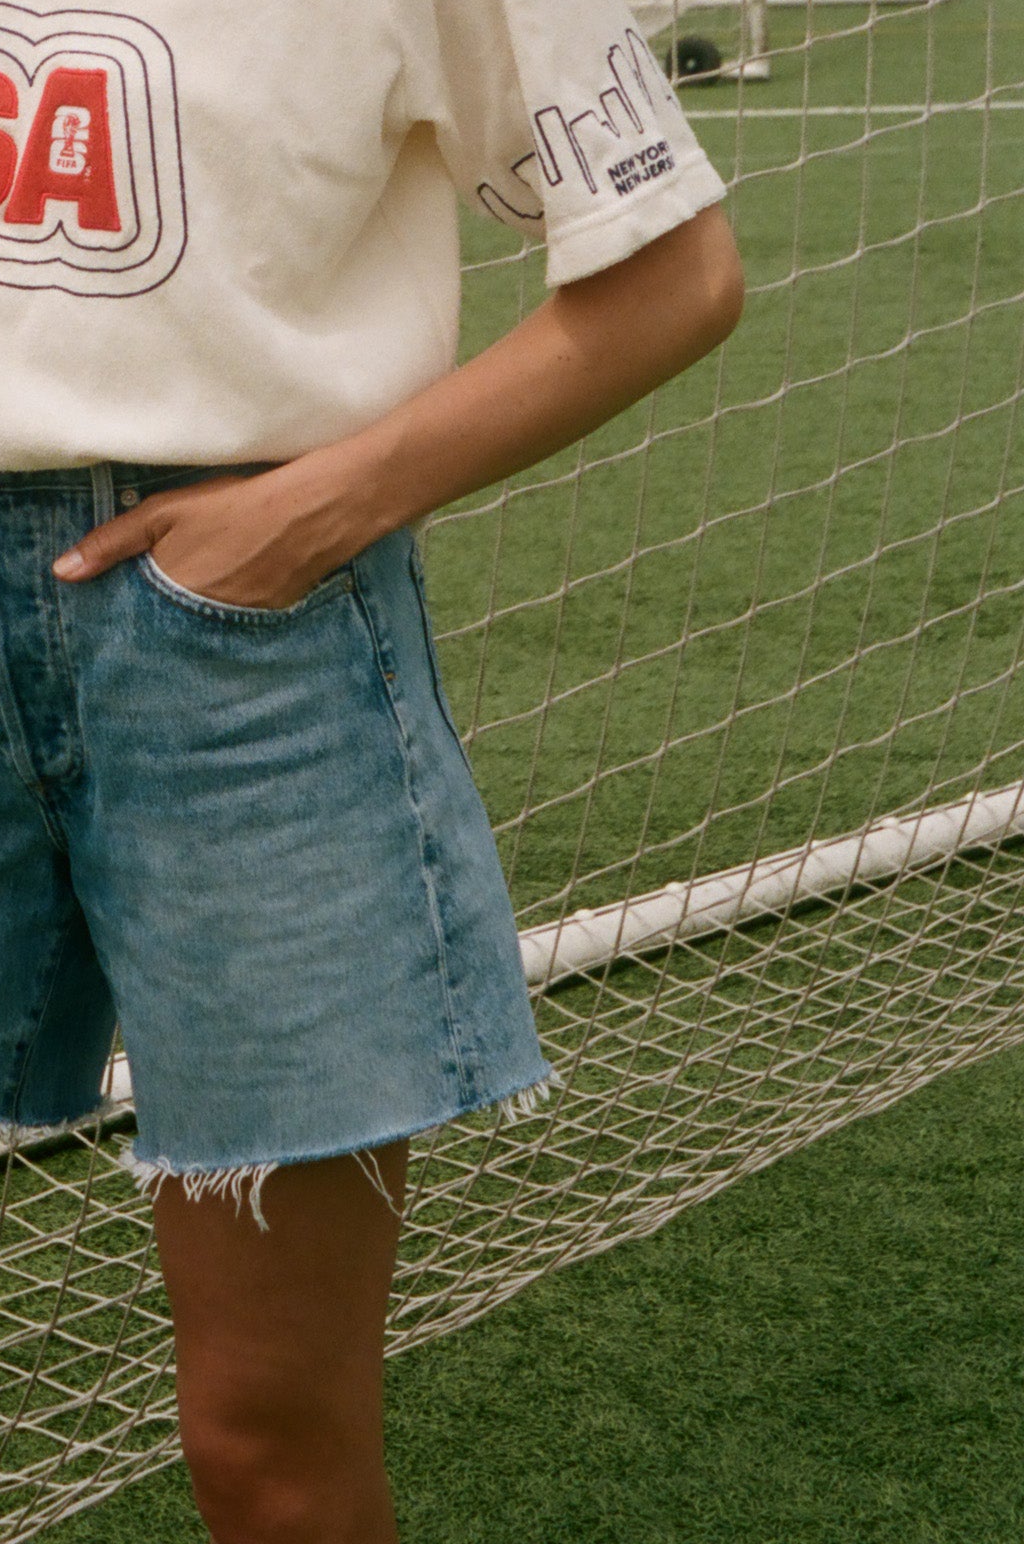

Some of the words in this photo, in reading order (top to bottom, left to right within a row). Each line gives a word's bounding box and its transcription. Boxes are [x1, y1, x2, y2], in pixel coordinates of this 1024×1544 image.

[56, 158, 77, 168] FIFA
[607, 158, 635, 182] NEW
[634, 141, 669, 166] YOR
[615, 173, 641, 196] NEW
[642, 156, 675, 181] JERS
